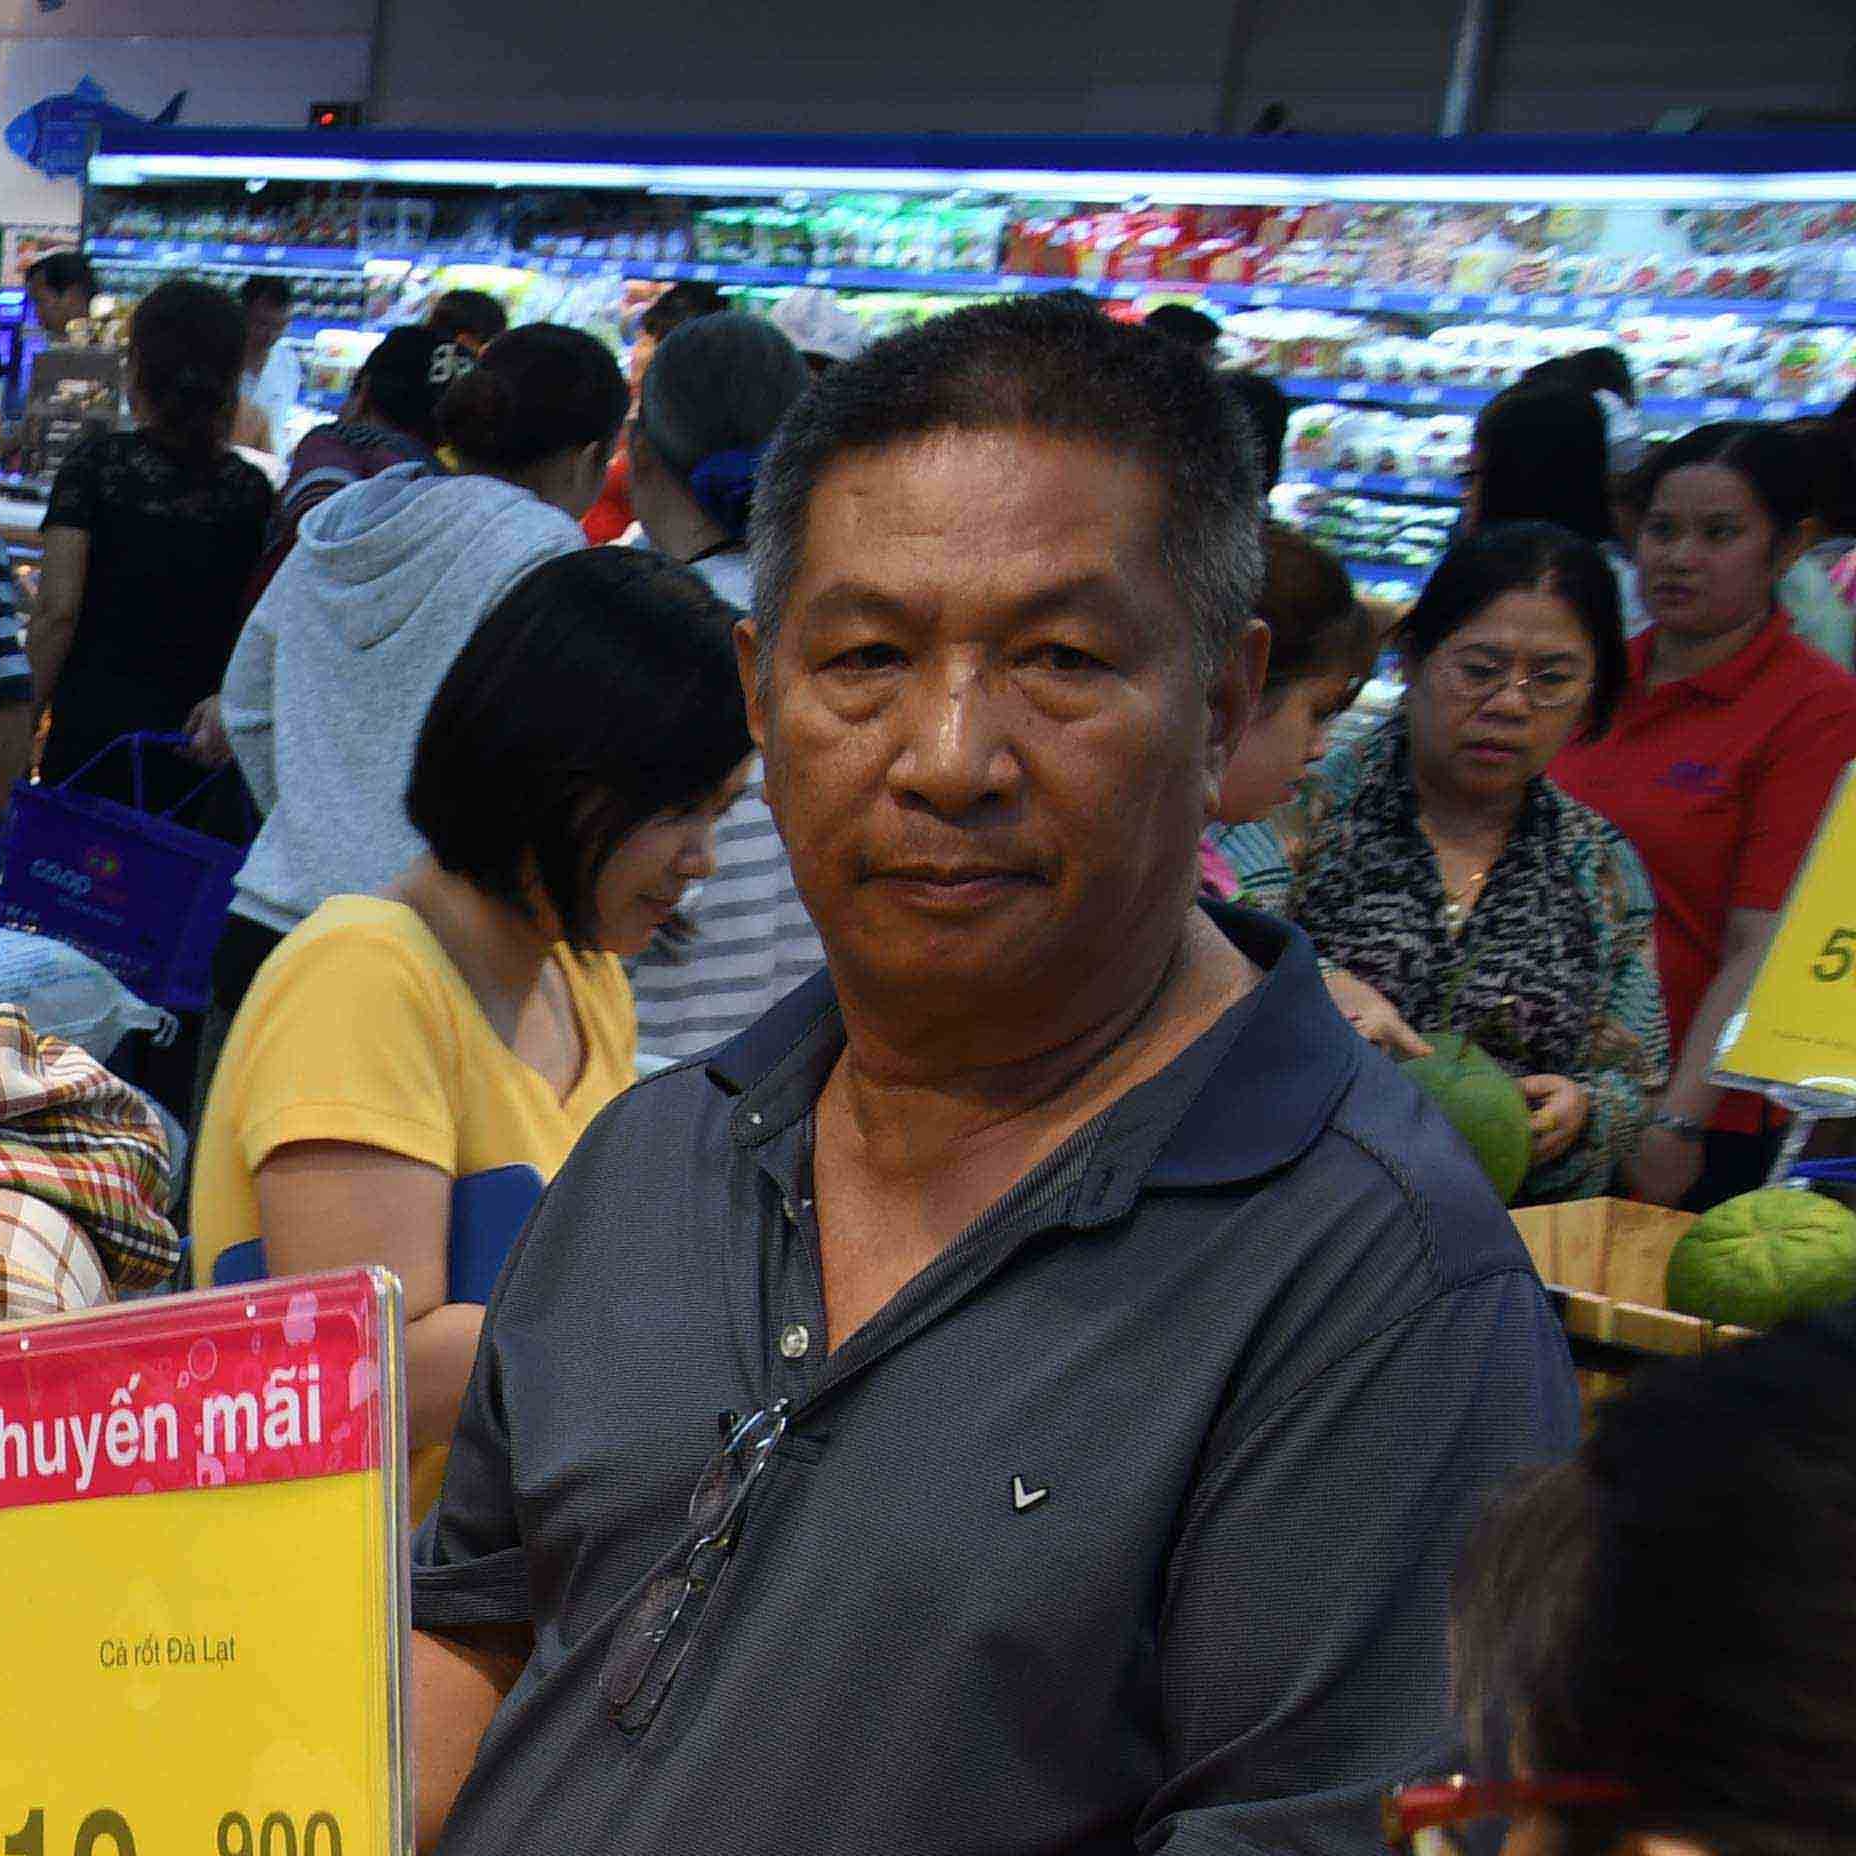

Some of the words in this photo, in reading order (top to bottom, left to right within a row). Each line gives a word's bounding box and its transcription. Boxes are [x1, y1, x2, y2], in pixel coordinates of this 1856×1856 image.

[201, 1363, 321, 1455] mãi
[133, 1633, 161, 1667] rốt
[167, 1635, 196, 1665] Đà
[203, 1633, 235, 1671] Lạt
